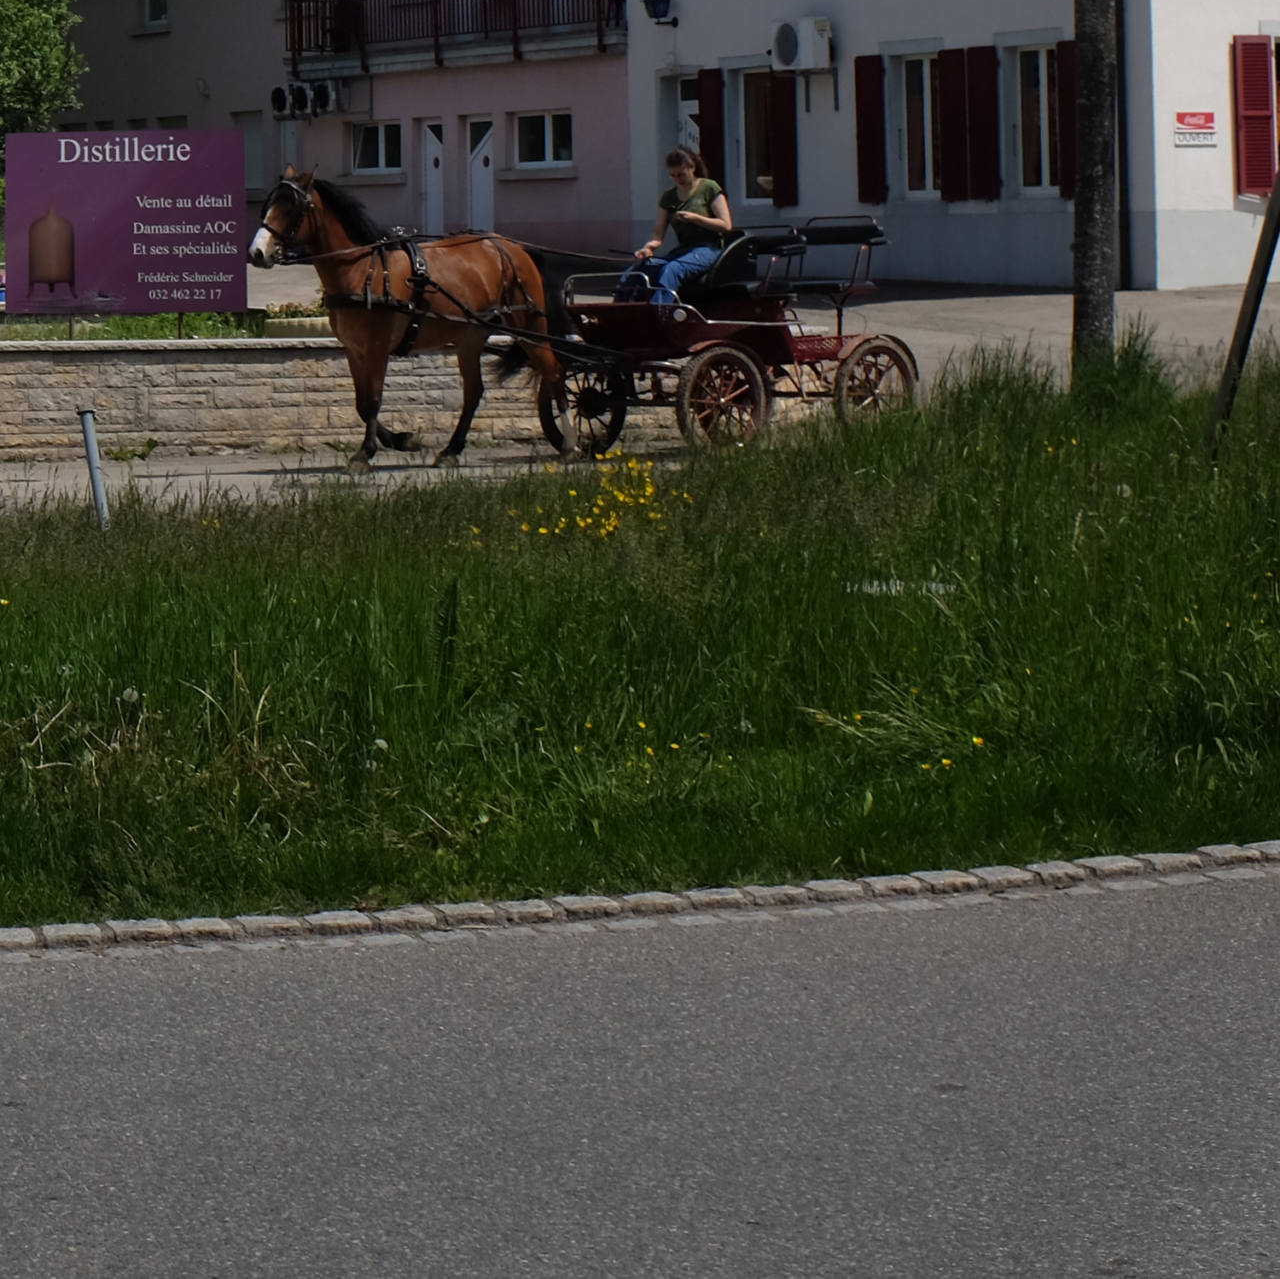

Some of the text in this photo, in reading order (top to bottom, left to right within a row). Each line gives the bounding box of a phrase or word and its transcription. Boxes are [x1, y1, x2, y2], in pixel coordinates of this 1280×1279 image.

[58, 136, 191, 163] Distillerie
[136, 194, 232, 209] Vente au détail
[133, 221, 237, 235] Damassine AOC
[133, 241, 238, 258] Et ses spécialités
[137, 271, 234, 283] Frédéric Schneider
[148, 289, 222, 300] 032 462 22 17
